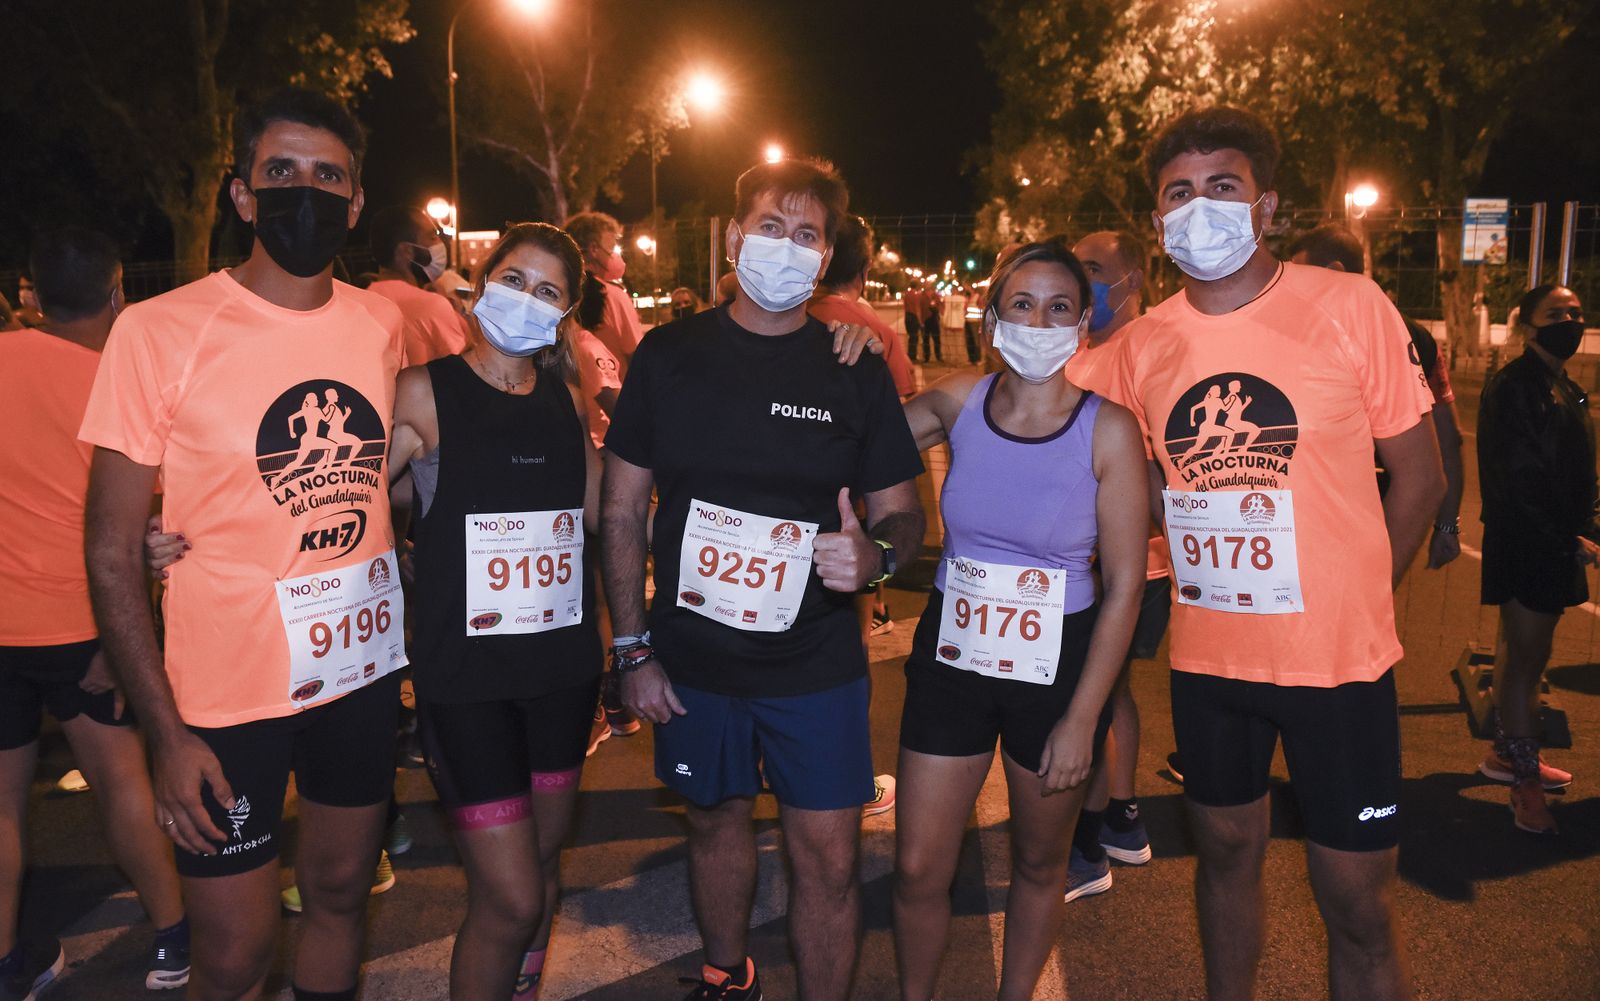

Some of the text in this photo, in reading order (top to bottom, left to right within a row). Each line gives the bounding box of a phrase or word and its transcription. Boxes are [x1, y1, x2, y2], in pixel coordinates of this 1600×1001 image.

[770, 402, 832, 423] POLICIA
[1181, 456, 1289, 483] LA NOCTURNA
[1195, 472, 1279, 492] del Guadalquivir
[273, 470, 379, 506] LA NOCTURNA
[290, 488, 373, 517] del Guadalquivir
[697, 545, 787, 593] 9251
[1182, 534, 1274, 571] 9178
[487, 552, 572, 591] 9195
[309, 599, 391, 659] 9196
[955, 597, 1041, 642] 9176
[222, 832, 272, 856] ANTORCHA
